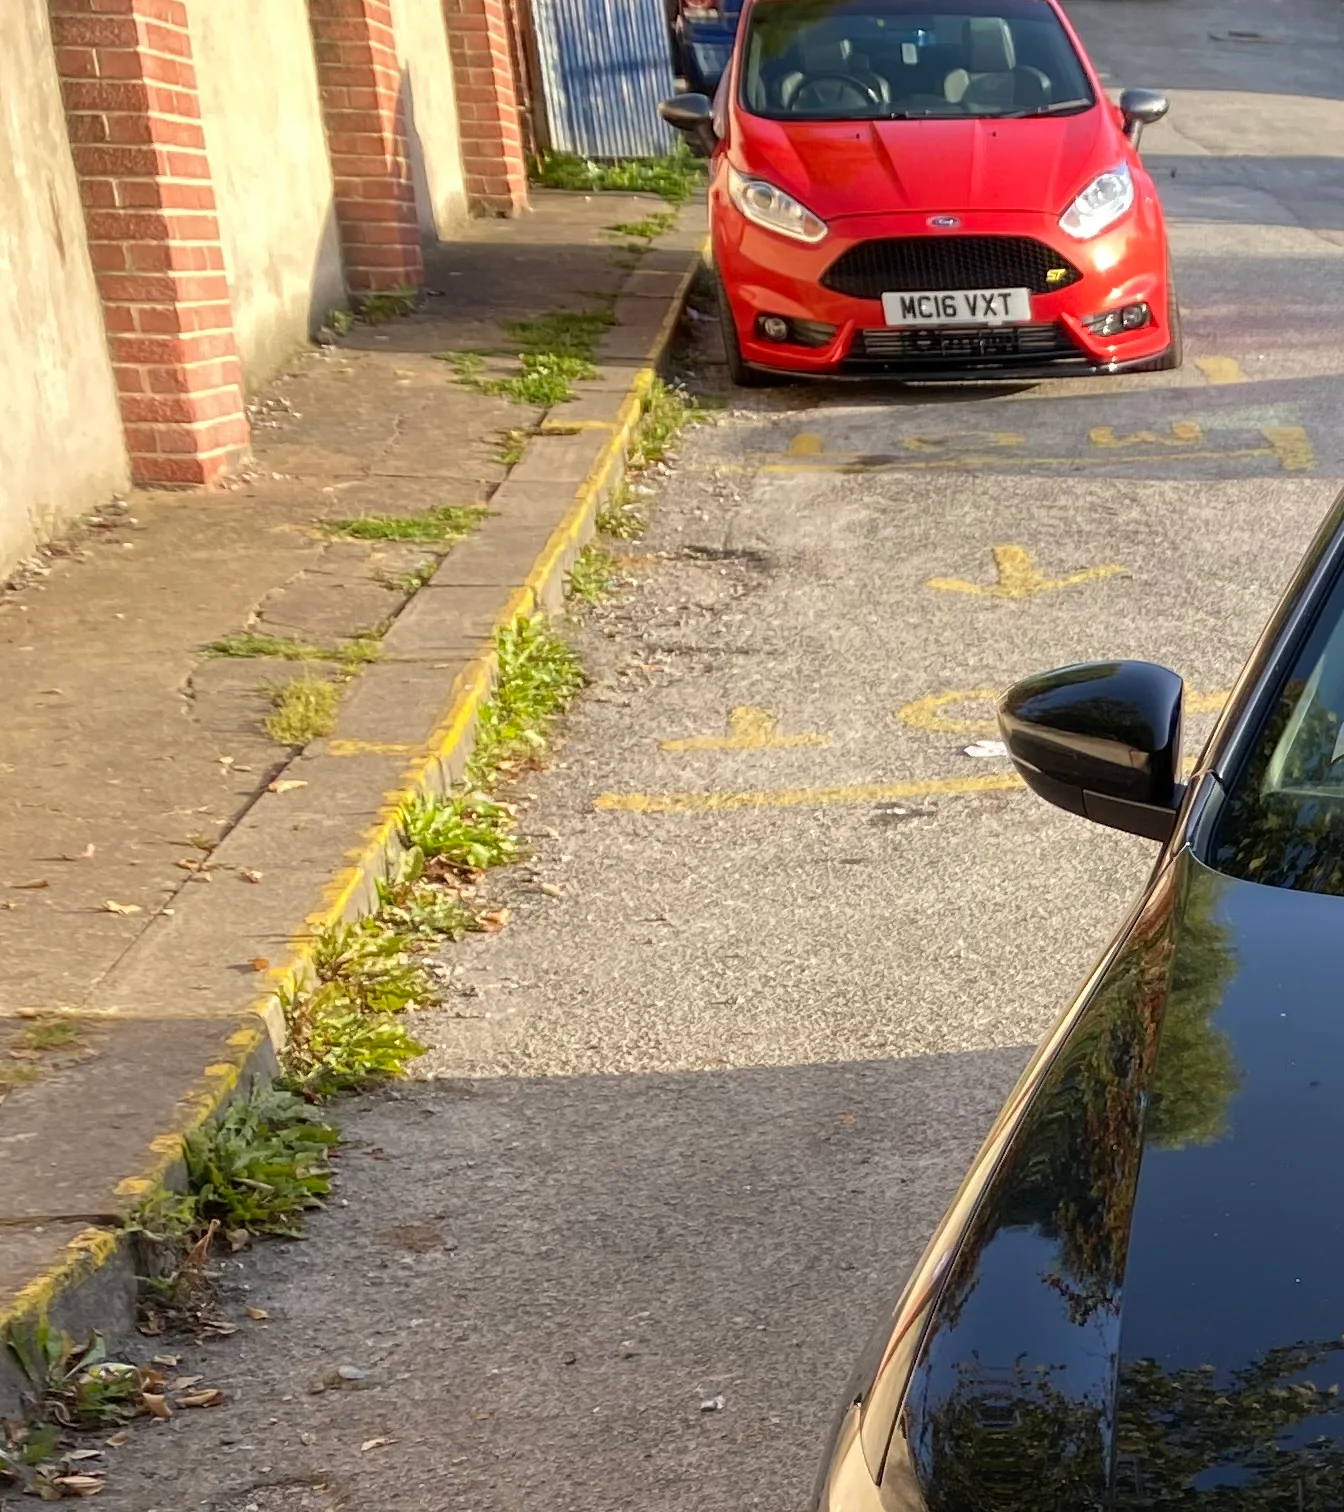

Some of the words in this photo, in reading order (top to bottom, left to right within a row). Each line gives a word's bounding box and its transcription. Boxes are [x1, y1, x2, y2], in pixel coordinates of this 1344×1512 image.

[1046, 269, 1065, 282] ST
[900, 295, 957, 319] MC16
[964, 292, 1012, 317] VXT
